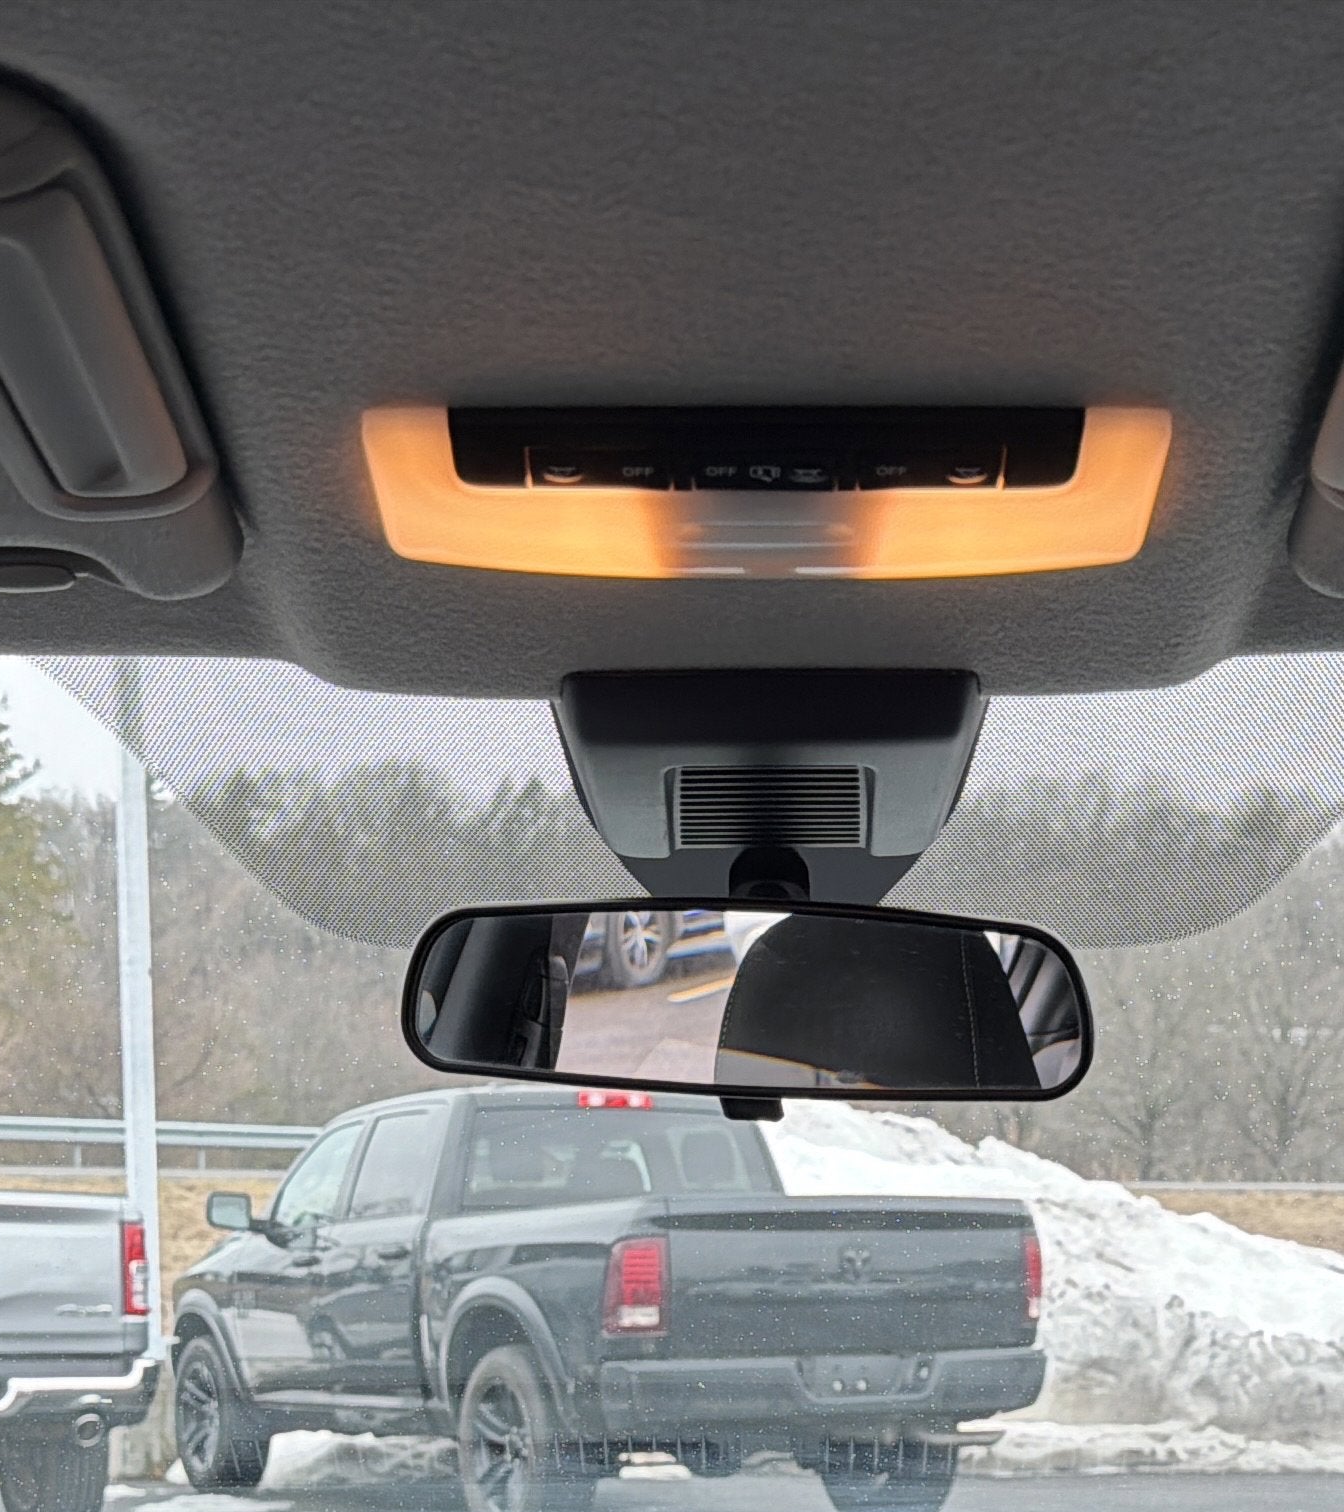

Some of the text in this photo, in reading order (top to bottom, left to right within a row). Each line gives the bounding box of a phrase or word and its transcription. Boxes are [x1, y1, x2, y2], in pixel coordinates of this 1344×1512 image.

[622, 466, 654, 477] OFF
[705, 466, 737, 477] OFF
[876, 466, 907, 477] OFF
